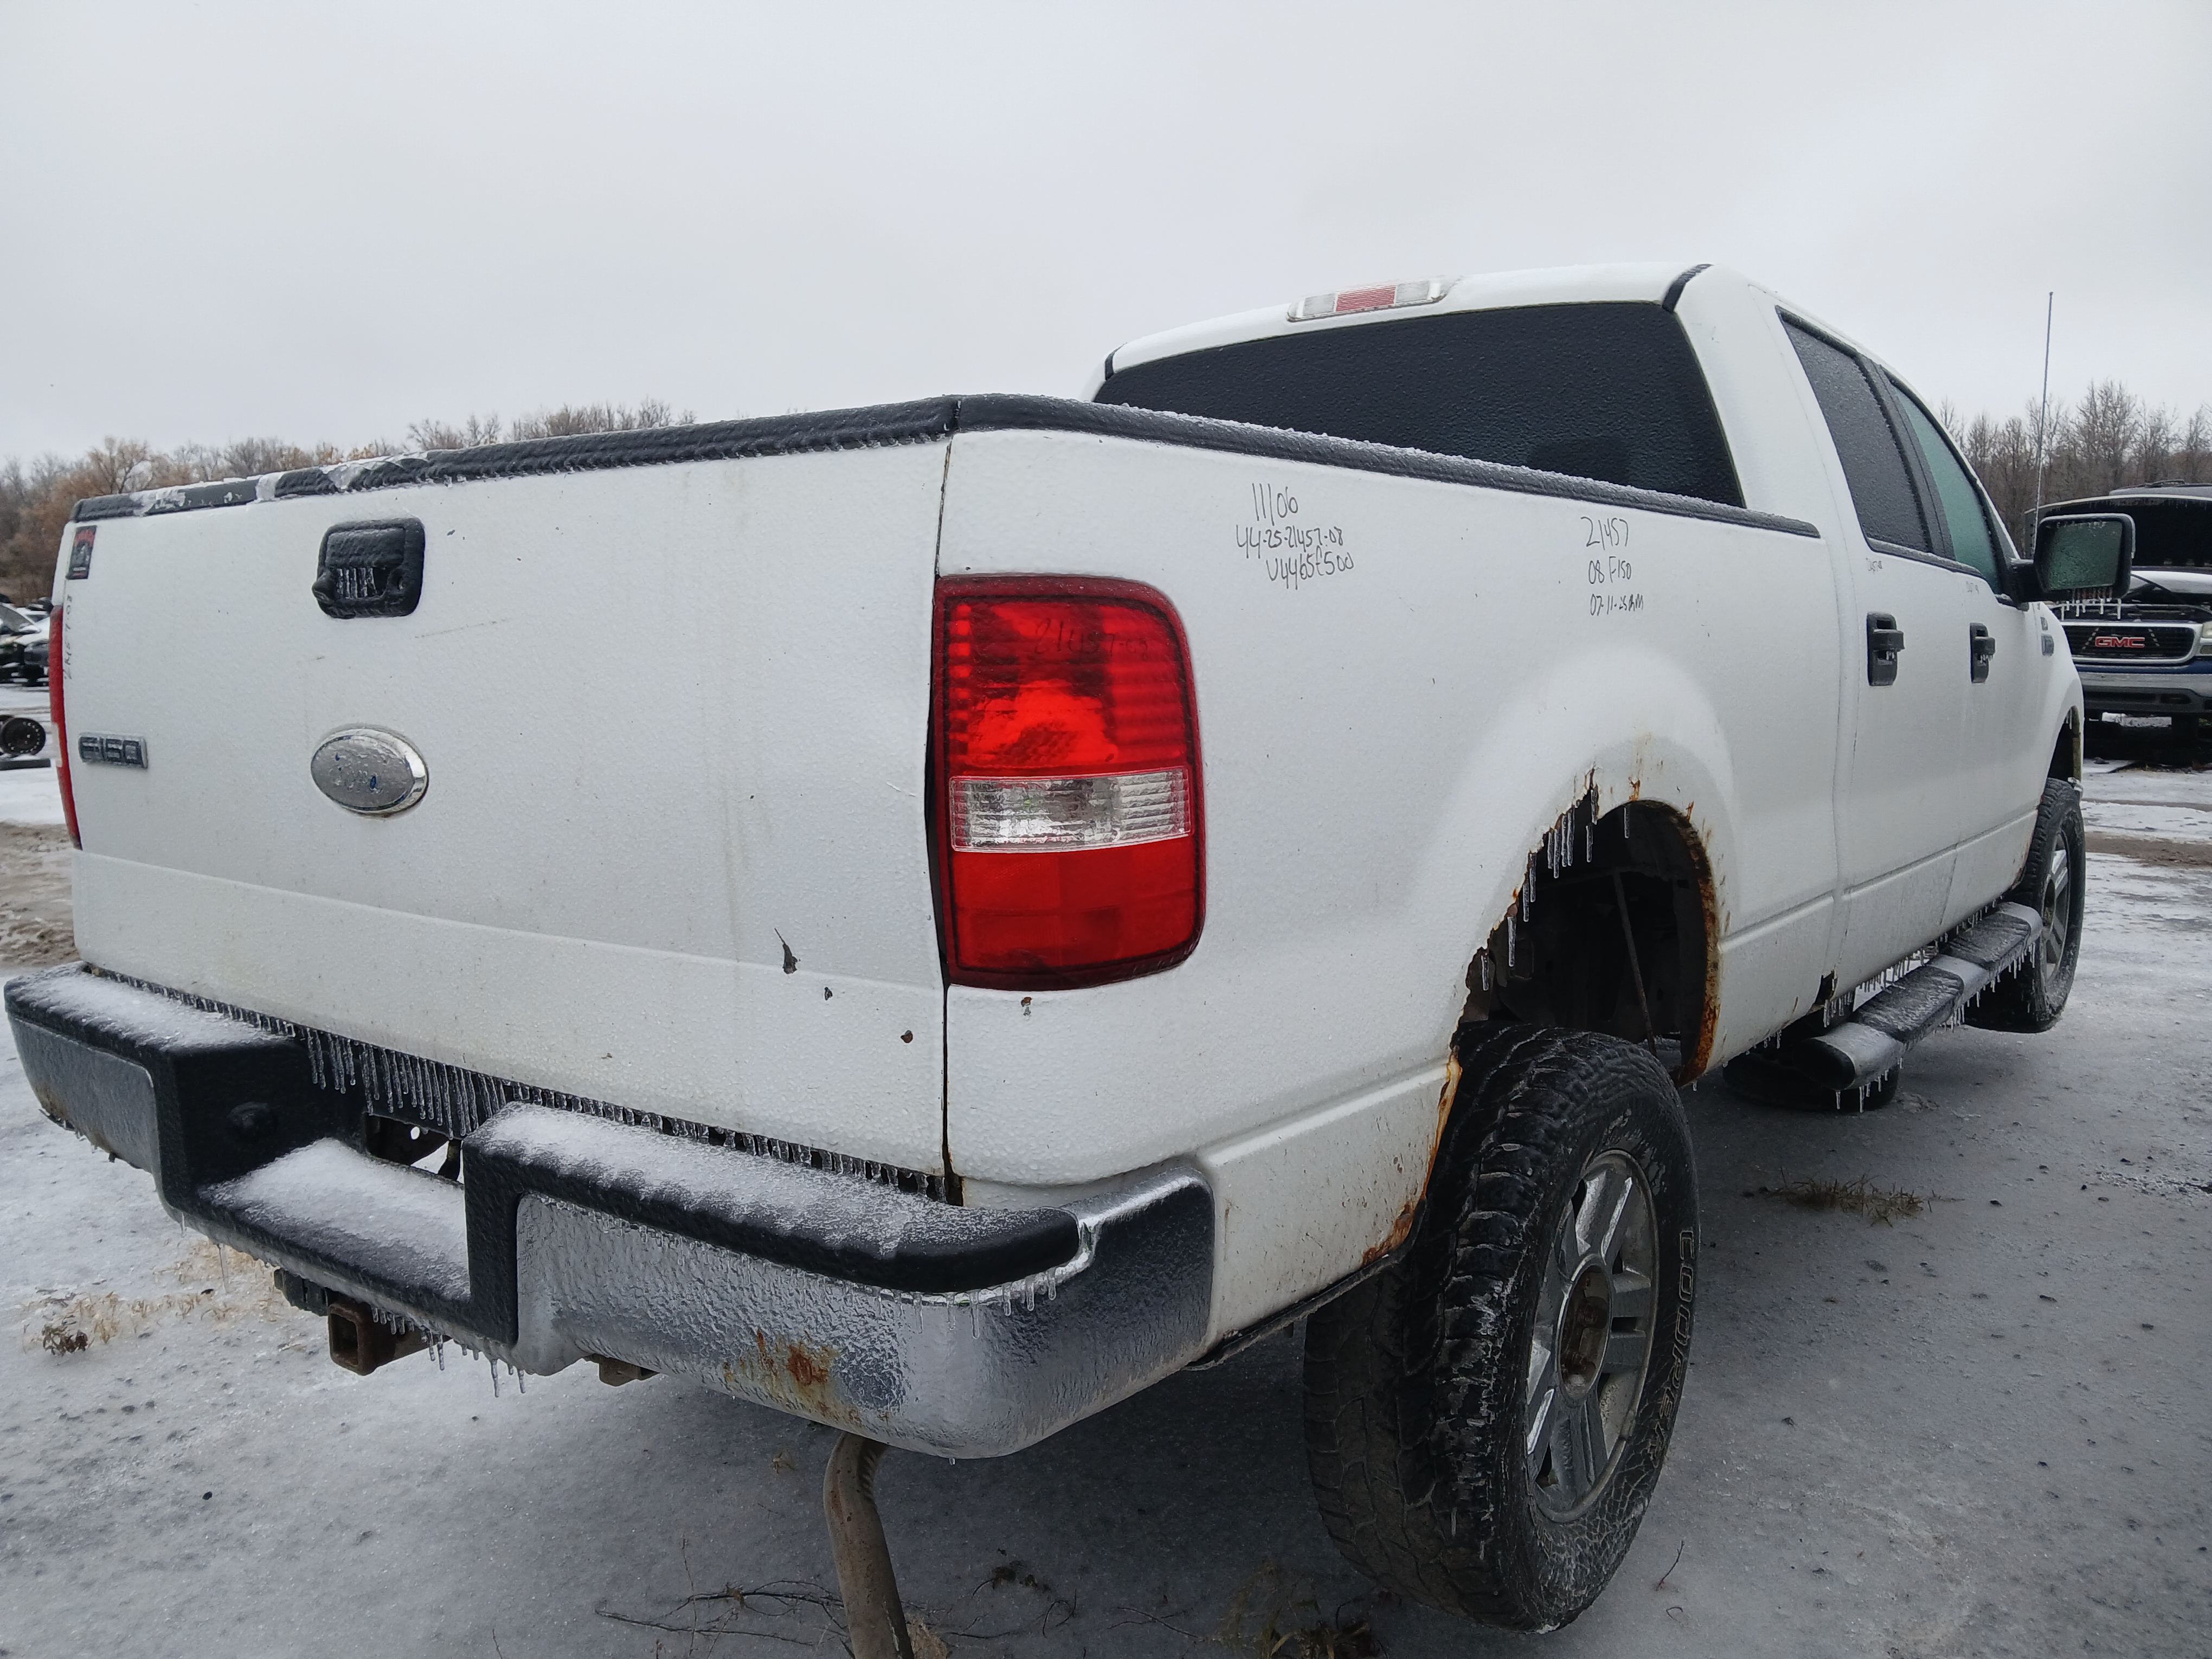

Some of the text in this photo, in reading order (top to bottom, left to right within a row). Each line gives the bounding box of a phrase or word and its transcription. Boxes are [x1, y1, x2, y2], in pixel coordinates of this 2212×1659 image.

[1580, 516, 1629, 550] 21457
[1588, 560, 1605, 584] 08
[2095, 636, 2145, 648] GMC
